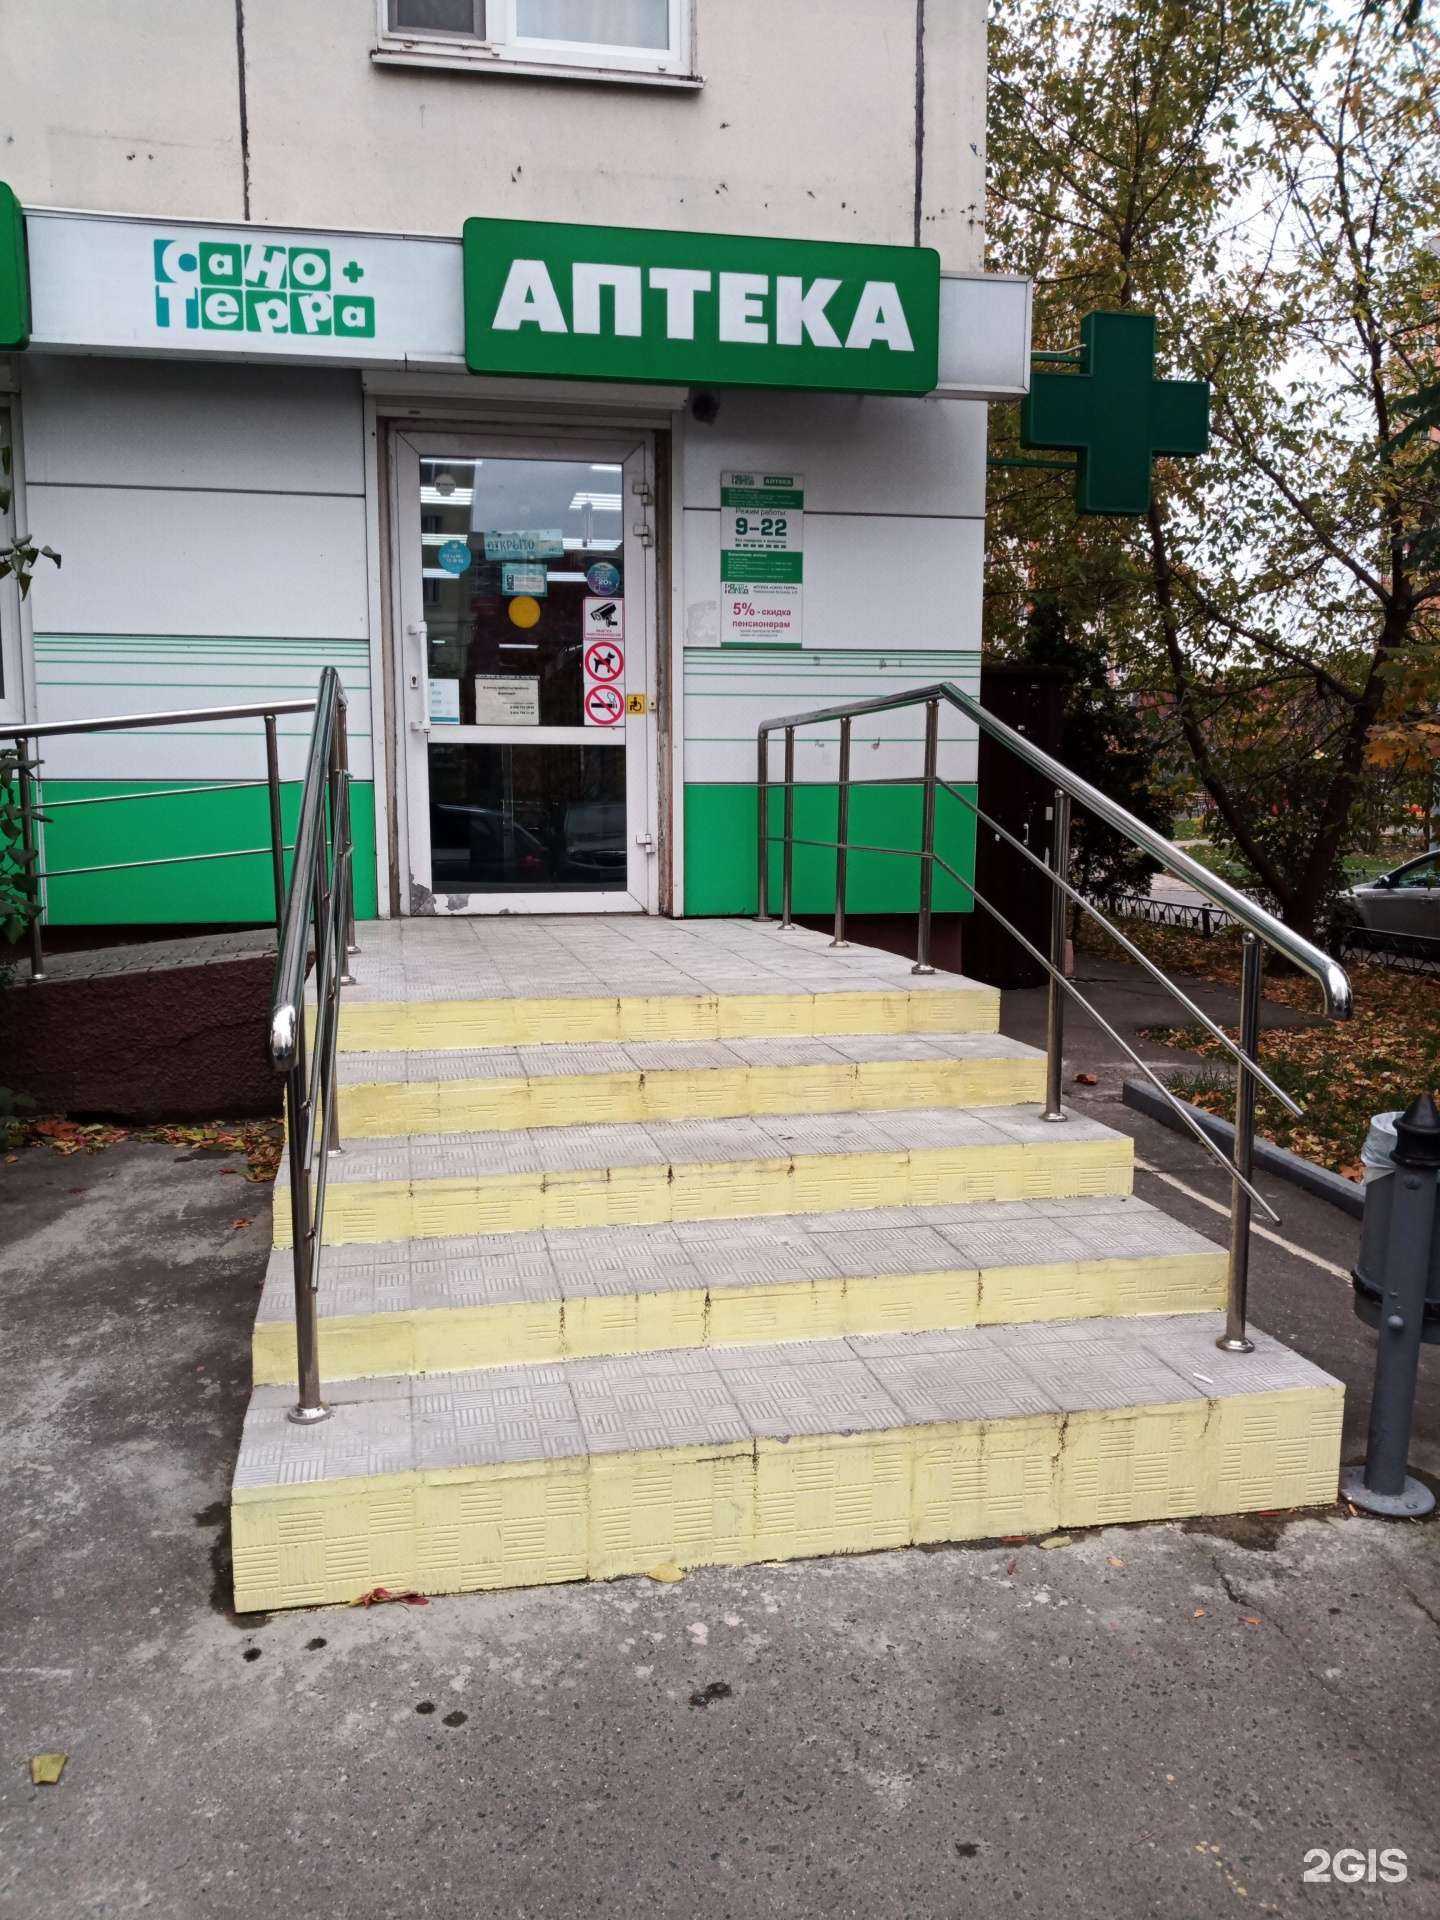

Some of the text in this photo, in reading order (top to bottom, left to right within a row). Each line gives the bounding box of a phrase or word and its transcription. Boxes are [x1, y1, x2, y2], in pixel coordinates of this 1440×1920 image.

[155, 285, 375, 337] Терра
[492, 259, 915, 351] АПТЕКА
[735, 506, 786, 516] Режим работы
[733, 602, 755, 616] 5%
[761, 609, 791, 617] скидка
[732, 620, 791, 629] пенсионерам
